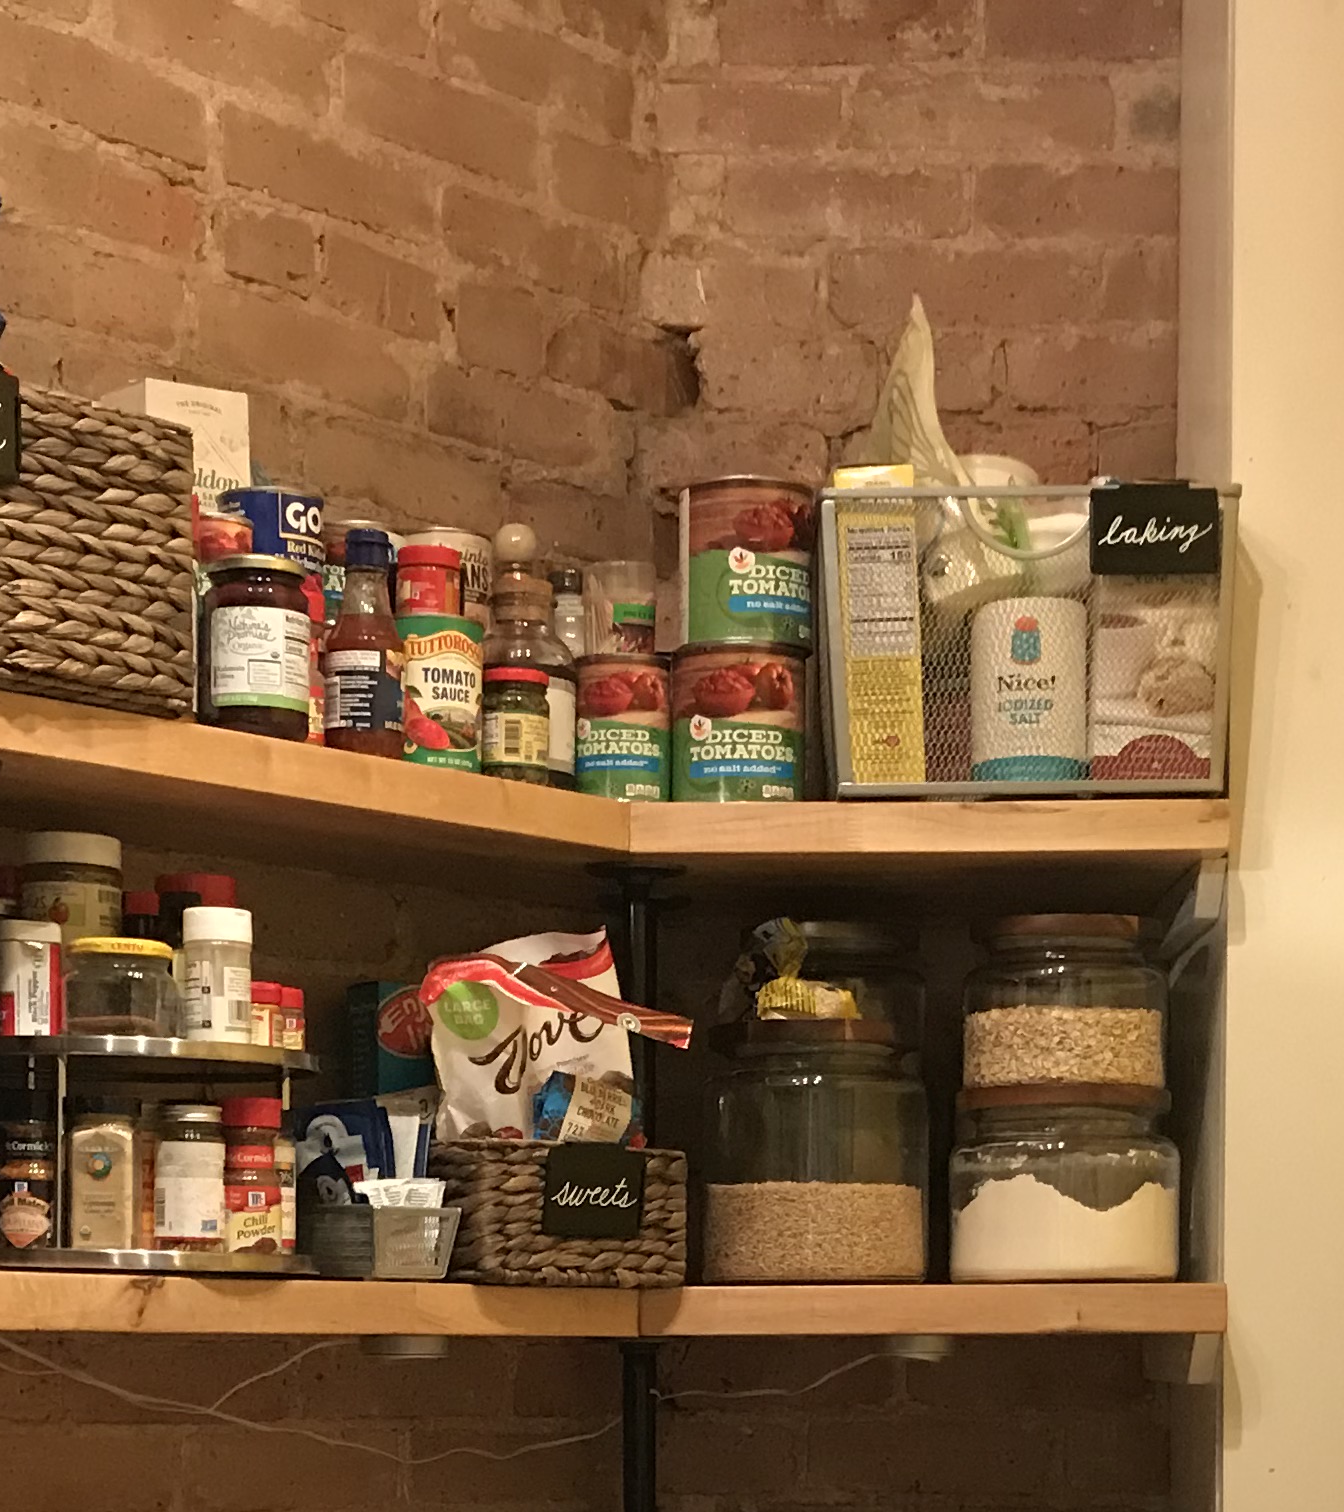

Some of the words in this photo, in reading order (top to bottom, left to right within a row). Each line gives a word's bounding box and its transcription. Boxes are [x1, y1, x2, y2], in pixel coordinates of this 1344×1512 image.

[1098, 516, 1213, 553] baking
[748, 564, 810, 585] DICED
[422, 667, 476, 689] TOMATO
[996, 673, 1056, 694] Nice!
[432, 686, 470, 704] SAUCE
[997, 699, 1054, 713] IODIZED
[1008, 713, 1041, 726] SALT
[586, 728, 650, 742] DICED
[705, 728, 783, 744] DICED
[577, 741, 660, 758] TOMATOES
[689, 742, 794, 763] TOMATOES
[703, 765, 717, 774] no
[444, 999, 492, 1013] LARGE
[454, 1013, 485, 1025] BAG
[551, 1178, 638, 1207] sweets
[243, 1213, 268, 1229] Chili
[236, 1224, 276, 1241] Powder
